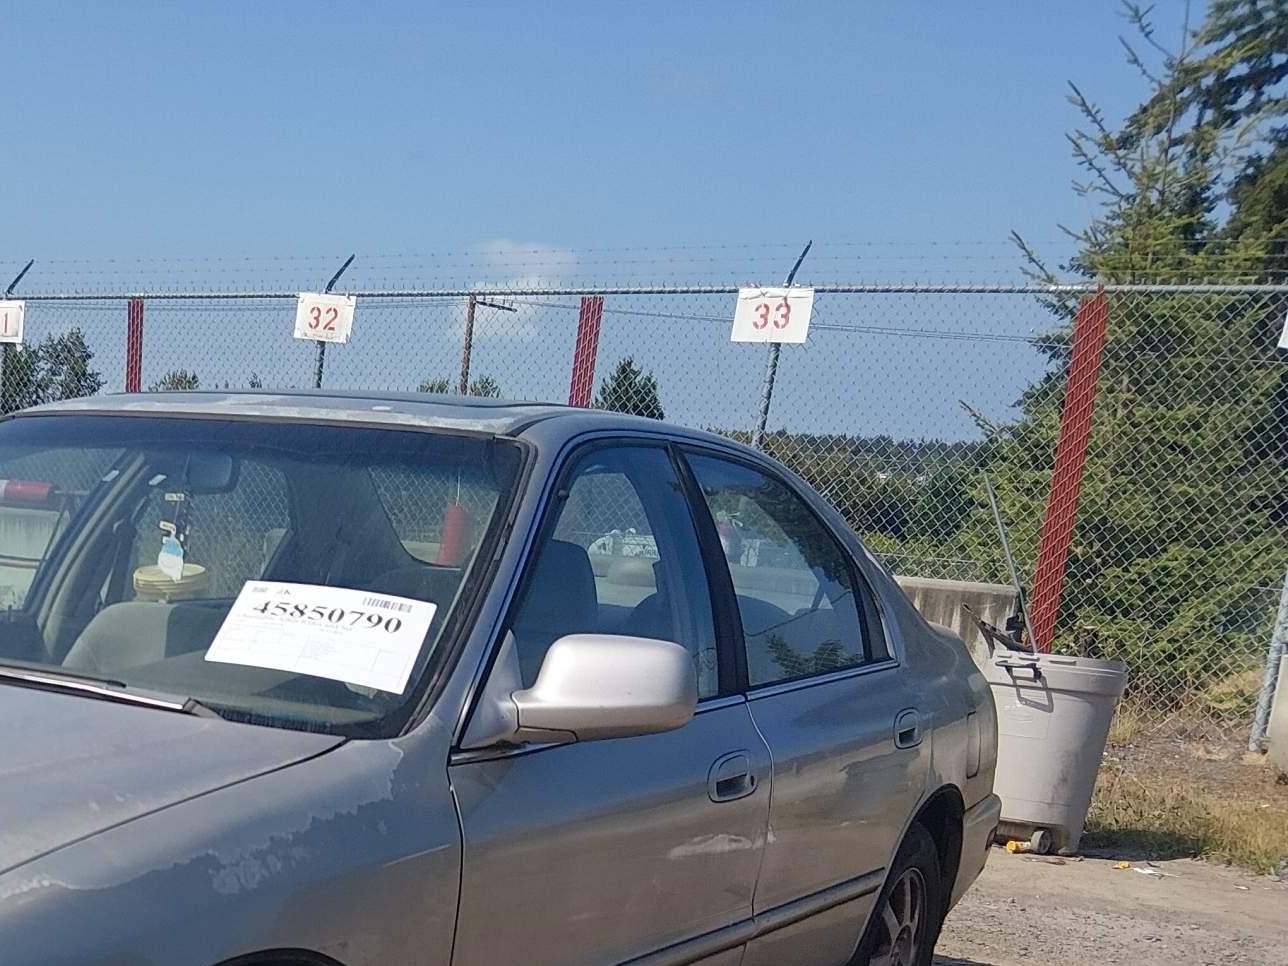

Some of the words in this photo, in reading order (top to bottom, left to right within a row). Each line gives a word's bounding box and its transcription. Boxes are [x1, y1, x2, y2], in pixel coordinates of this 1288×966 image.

[308, 306, 339, 331] 32
[752, 303, 791, 330] 33
[253, 599, 403, 634] 45850790
